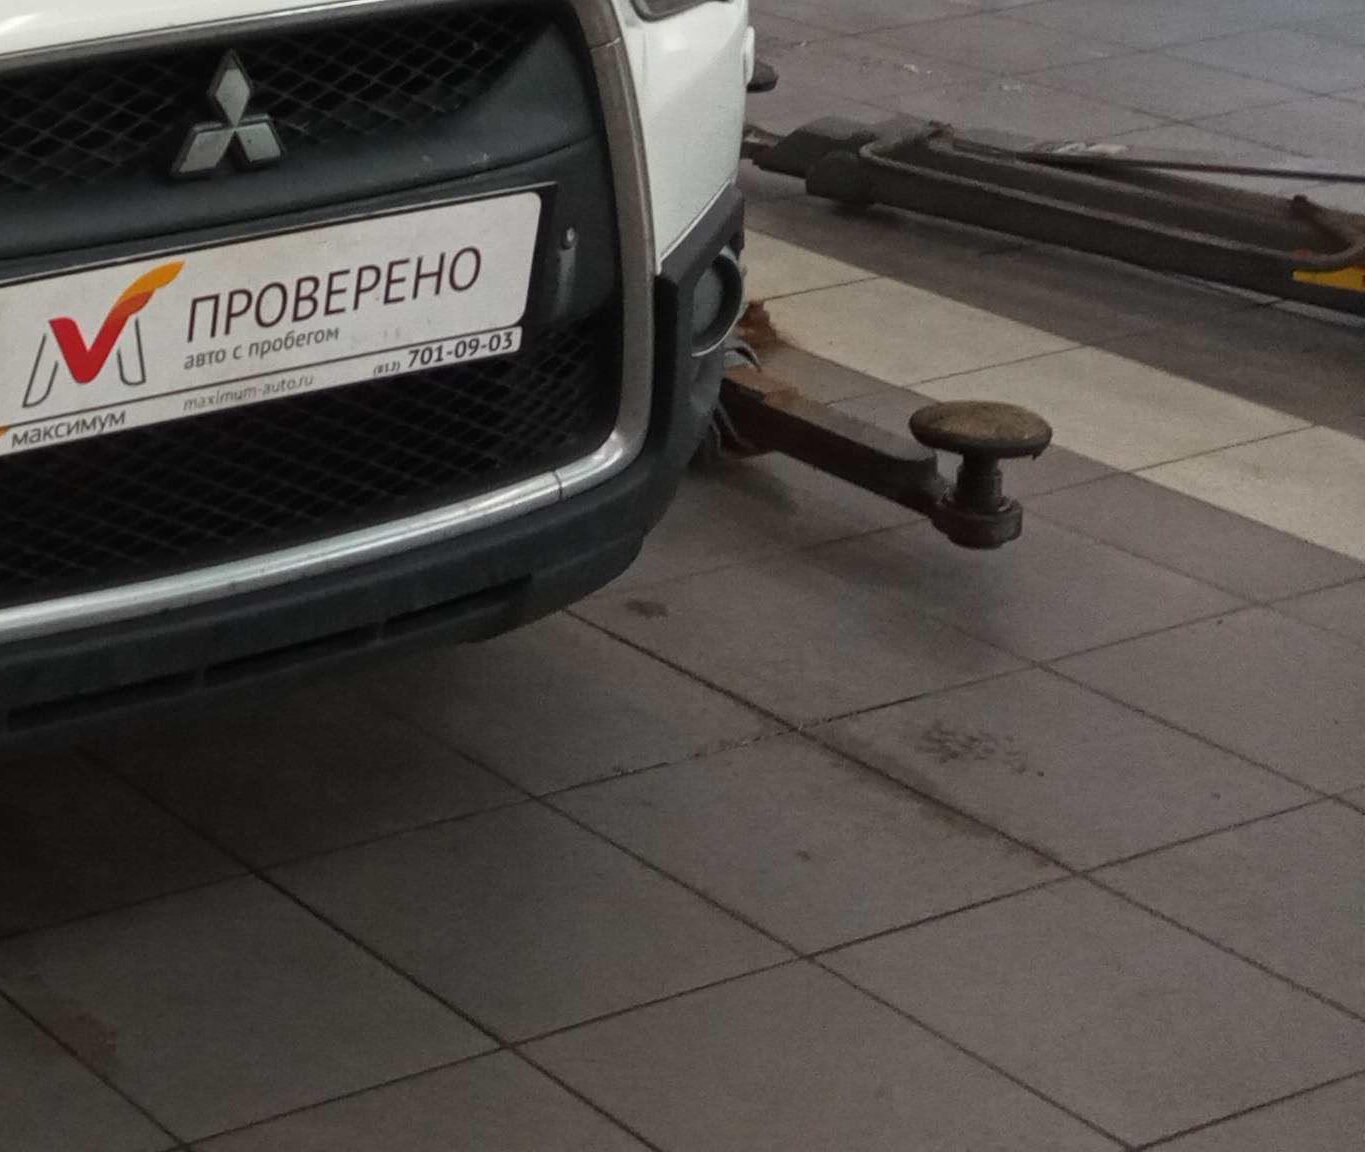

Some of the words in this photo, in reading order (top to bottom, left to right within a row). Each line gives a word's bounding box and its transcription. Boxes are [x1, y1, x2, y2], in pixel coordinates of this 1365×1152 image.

[186, 245, 482, 343] ПРОВЕРЕНО
[183, 349, 226, 370] авто
[232, 344, 243, 360] с
[248, 326, 340, 357] пробегом
[407, 330, 514, 369] 701-09-03
[183, 373, 314, 411] maximum-auto.ru
[11, 409, 126, 449] максимум
